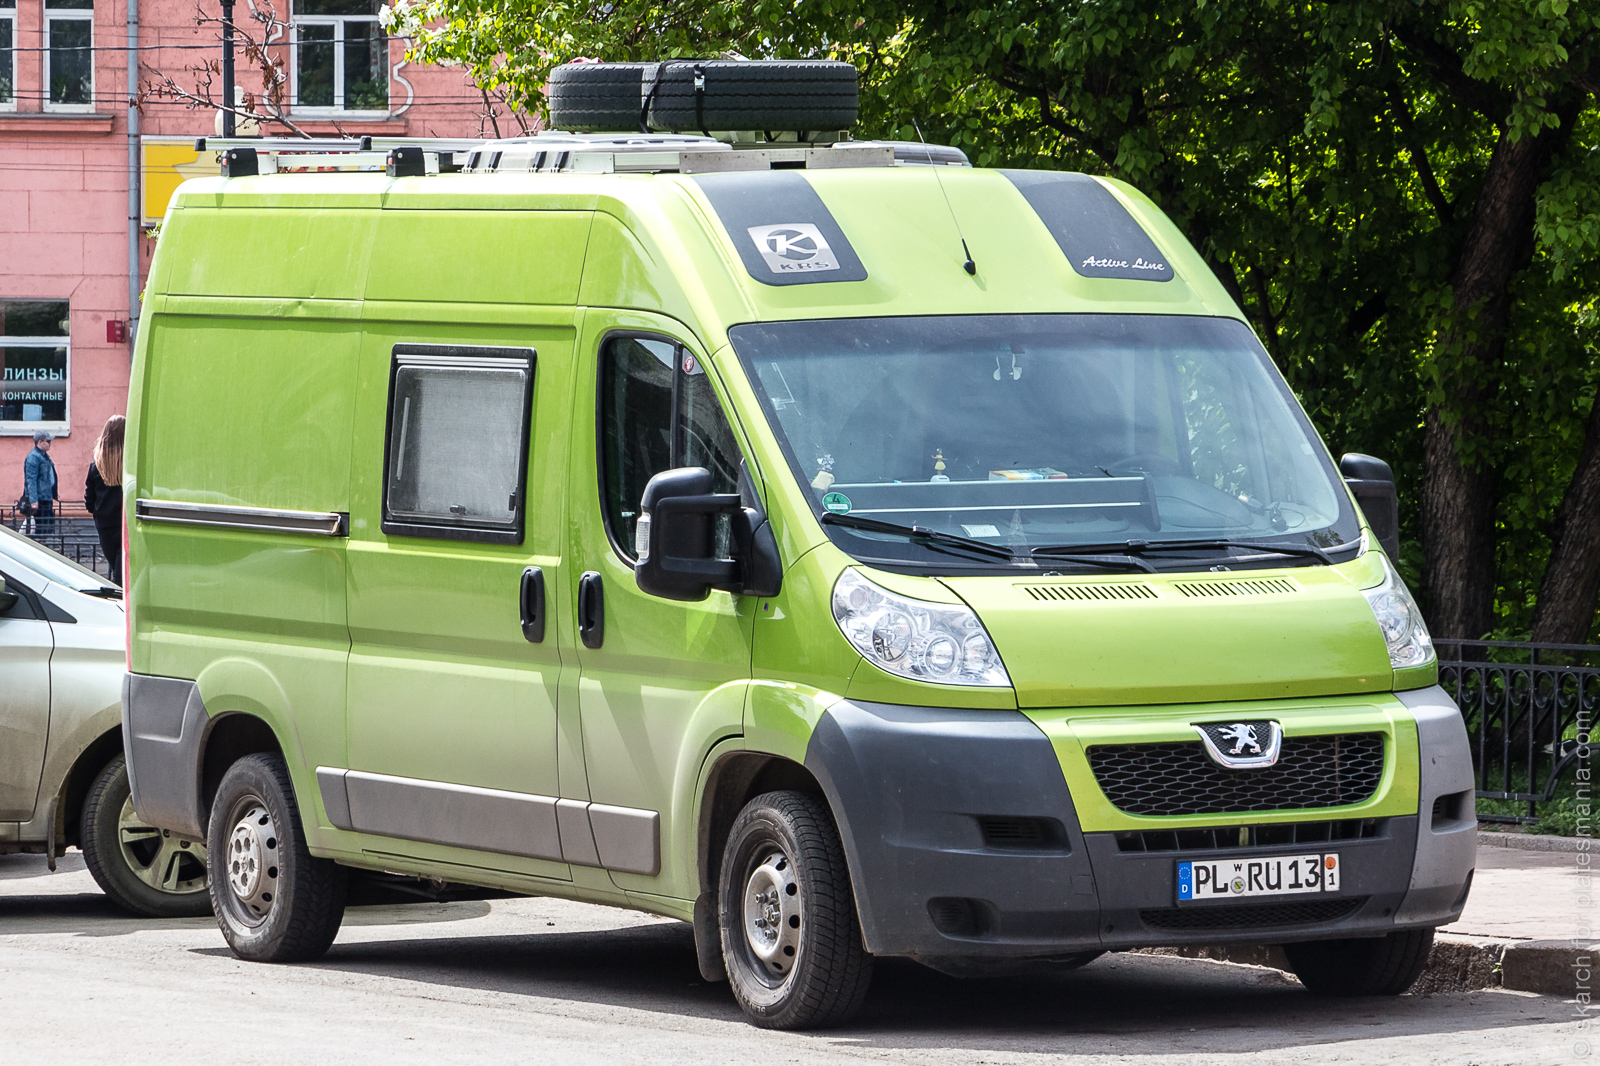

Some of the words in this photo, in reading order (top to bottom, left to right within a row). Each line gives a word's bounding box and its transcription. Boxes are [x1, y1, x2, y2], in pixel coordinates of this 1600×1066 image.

[1082, 255, 1129, 268] Active
[1131, 257, 1165, 271] Line
[3, 367, 63, 381] ЛИНЗЫ
[2, 391, 63, 401] КОНТАКТНЫЕ
[832, 494, 840, 504] 4
[1181, 884, 1189, 894] D
[1194, 864, 1229, 894] PL
[1288, 859, 1320, 889] 13
[1328, 872, 1335, 886] 1
